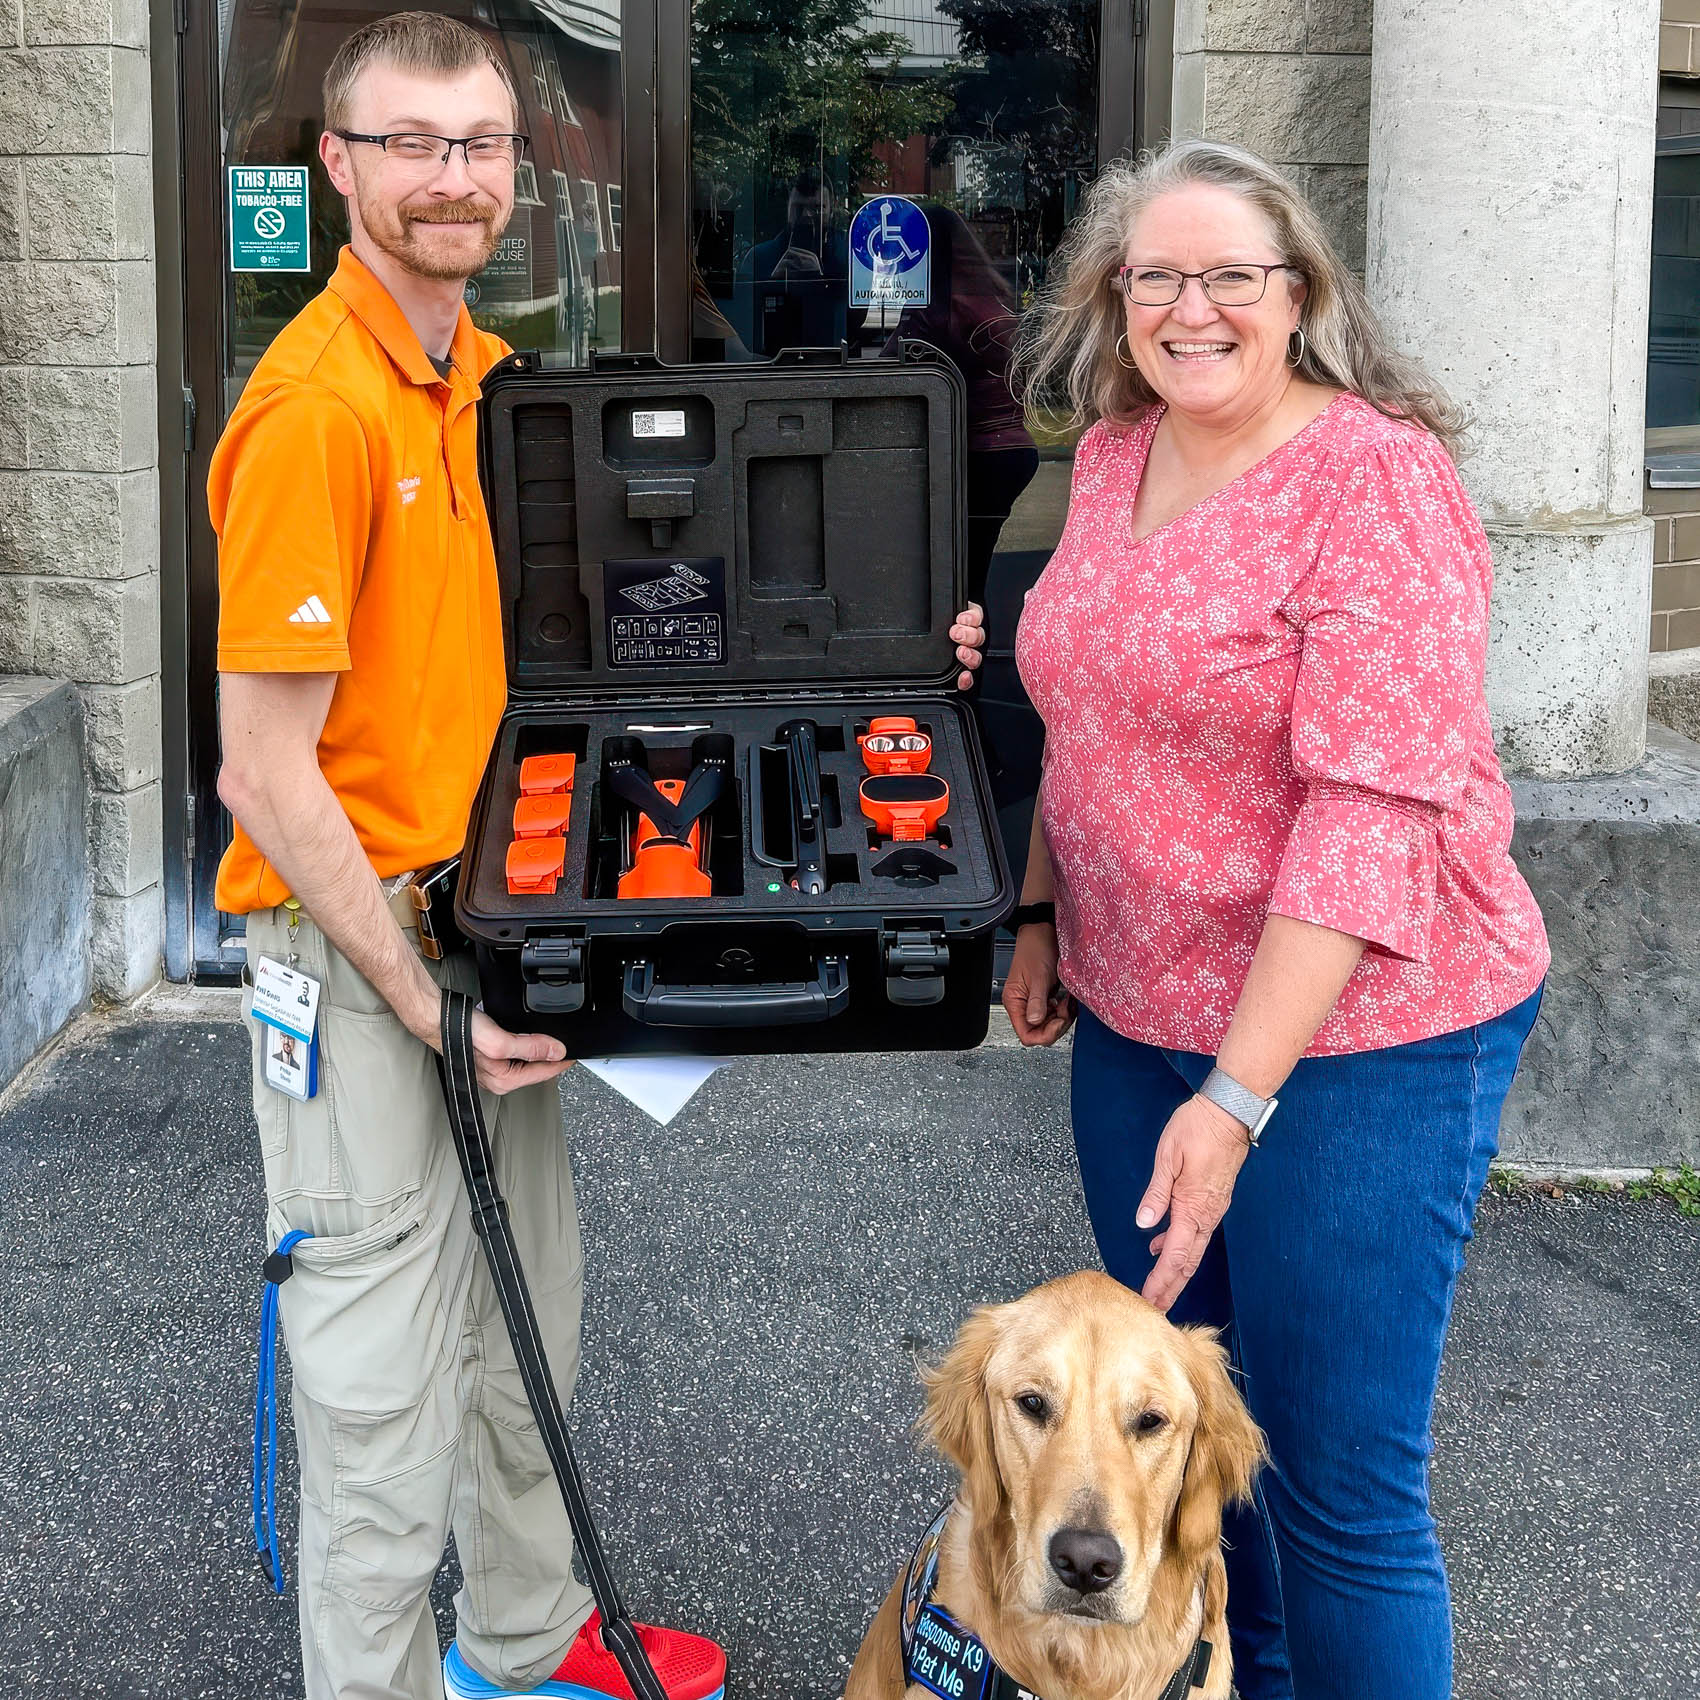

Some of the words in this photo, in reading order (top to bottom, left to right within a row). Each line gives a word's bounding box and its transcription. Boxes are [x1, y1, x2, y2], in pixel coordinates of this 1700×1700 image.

[236, 171, 265, 188] THIS
[268, 171, 303, 188] AREA
[235, 194, 303, 207] TOBACCO-FREE
[491, 250, 525, 261] OUSE
[855, 289, 900, 299] AUTOIC
[901, 289, 925, 300] DOOR
[961, 1640, 984, 1673] K9
[914, 1646, 938, 1679] Pet
[937, 1661, 964, 1697] Me
